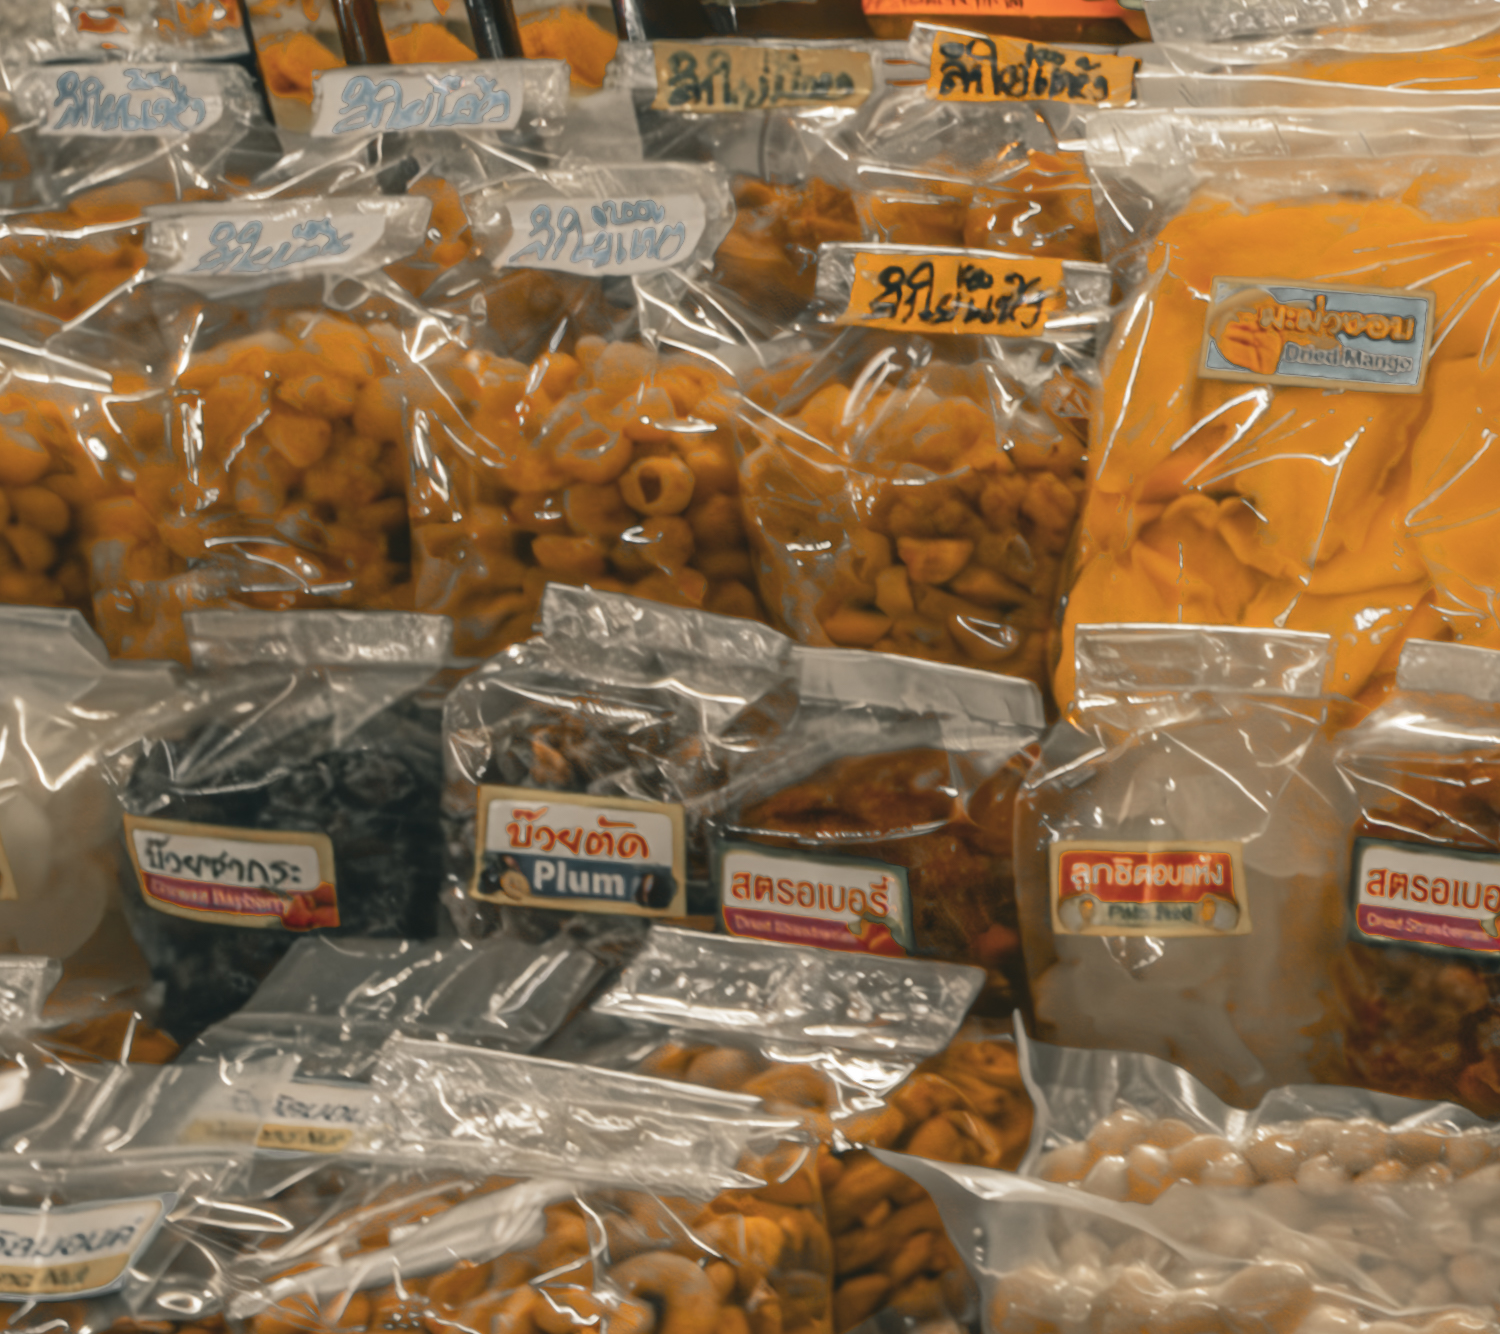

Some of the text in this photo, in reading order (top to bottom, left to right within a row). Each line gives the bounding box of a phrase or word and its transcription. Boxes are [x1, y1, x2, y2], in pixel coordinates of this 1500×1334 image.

[1343, 347, 1414, 375] Mango
[506, 805, 650, 859] บ๊วยตัด
[532, 857, 627, 901] Plum
